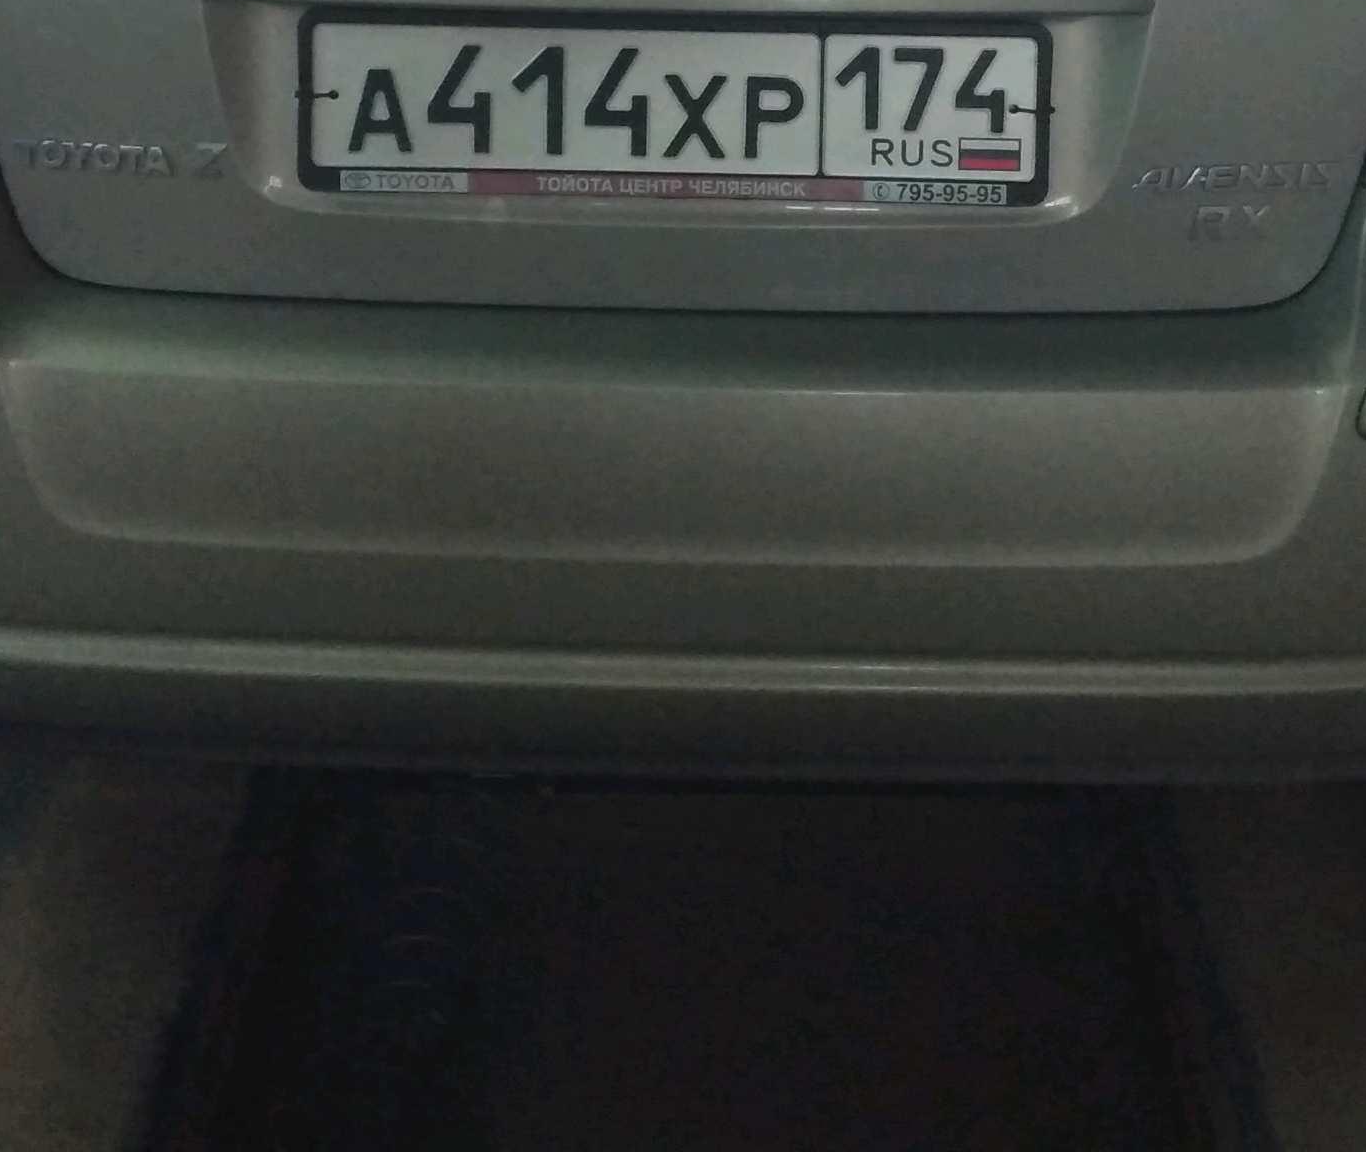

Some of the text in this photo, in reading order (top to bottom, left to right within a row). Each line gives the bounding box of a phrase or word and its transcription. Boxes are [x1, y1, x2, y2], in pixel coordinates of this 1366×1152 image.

[835, 48, 1009, 135] 174
[13, 138, 176, 176] TOYOTA
[871, 138, 954, 168] RUS
[377, 173, 455, 190] TOYOTA
[536, 175, 807, 198] ТОЙОТА ЦЕНТР ЧЕЛЯБИНСК
[1132, 162, 1338, 192] AVENSIS
[896, 183, 1004, 204] 795-95-95
